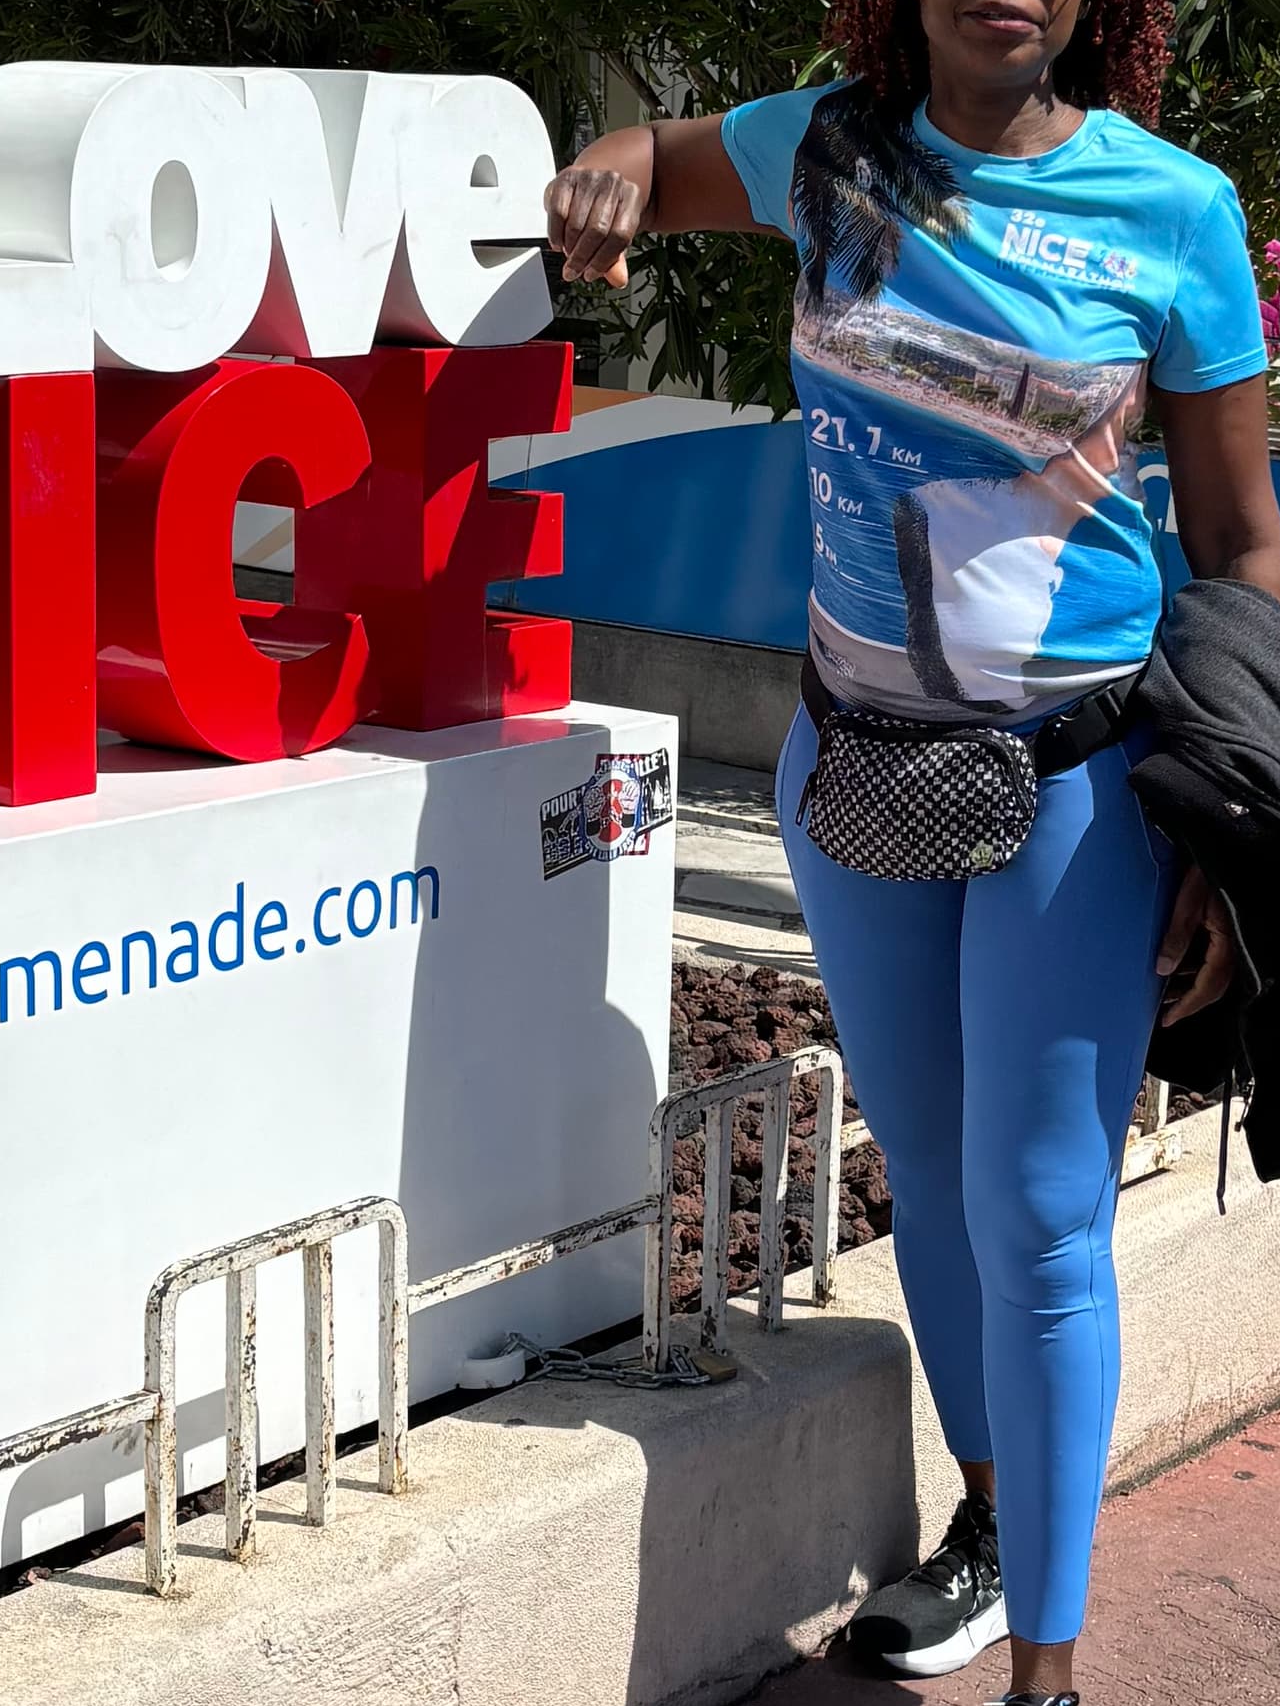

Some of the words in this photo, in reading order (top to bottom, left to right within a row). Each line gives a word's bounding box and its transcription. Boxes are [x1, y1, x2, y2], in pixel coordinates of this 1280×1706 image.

[999, 223, 1094, 269] NICE
[891, 446, 922, 466] KM
[810, 467, 832, 503] 10
[837, 496, 863, 515] KM
